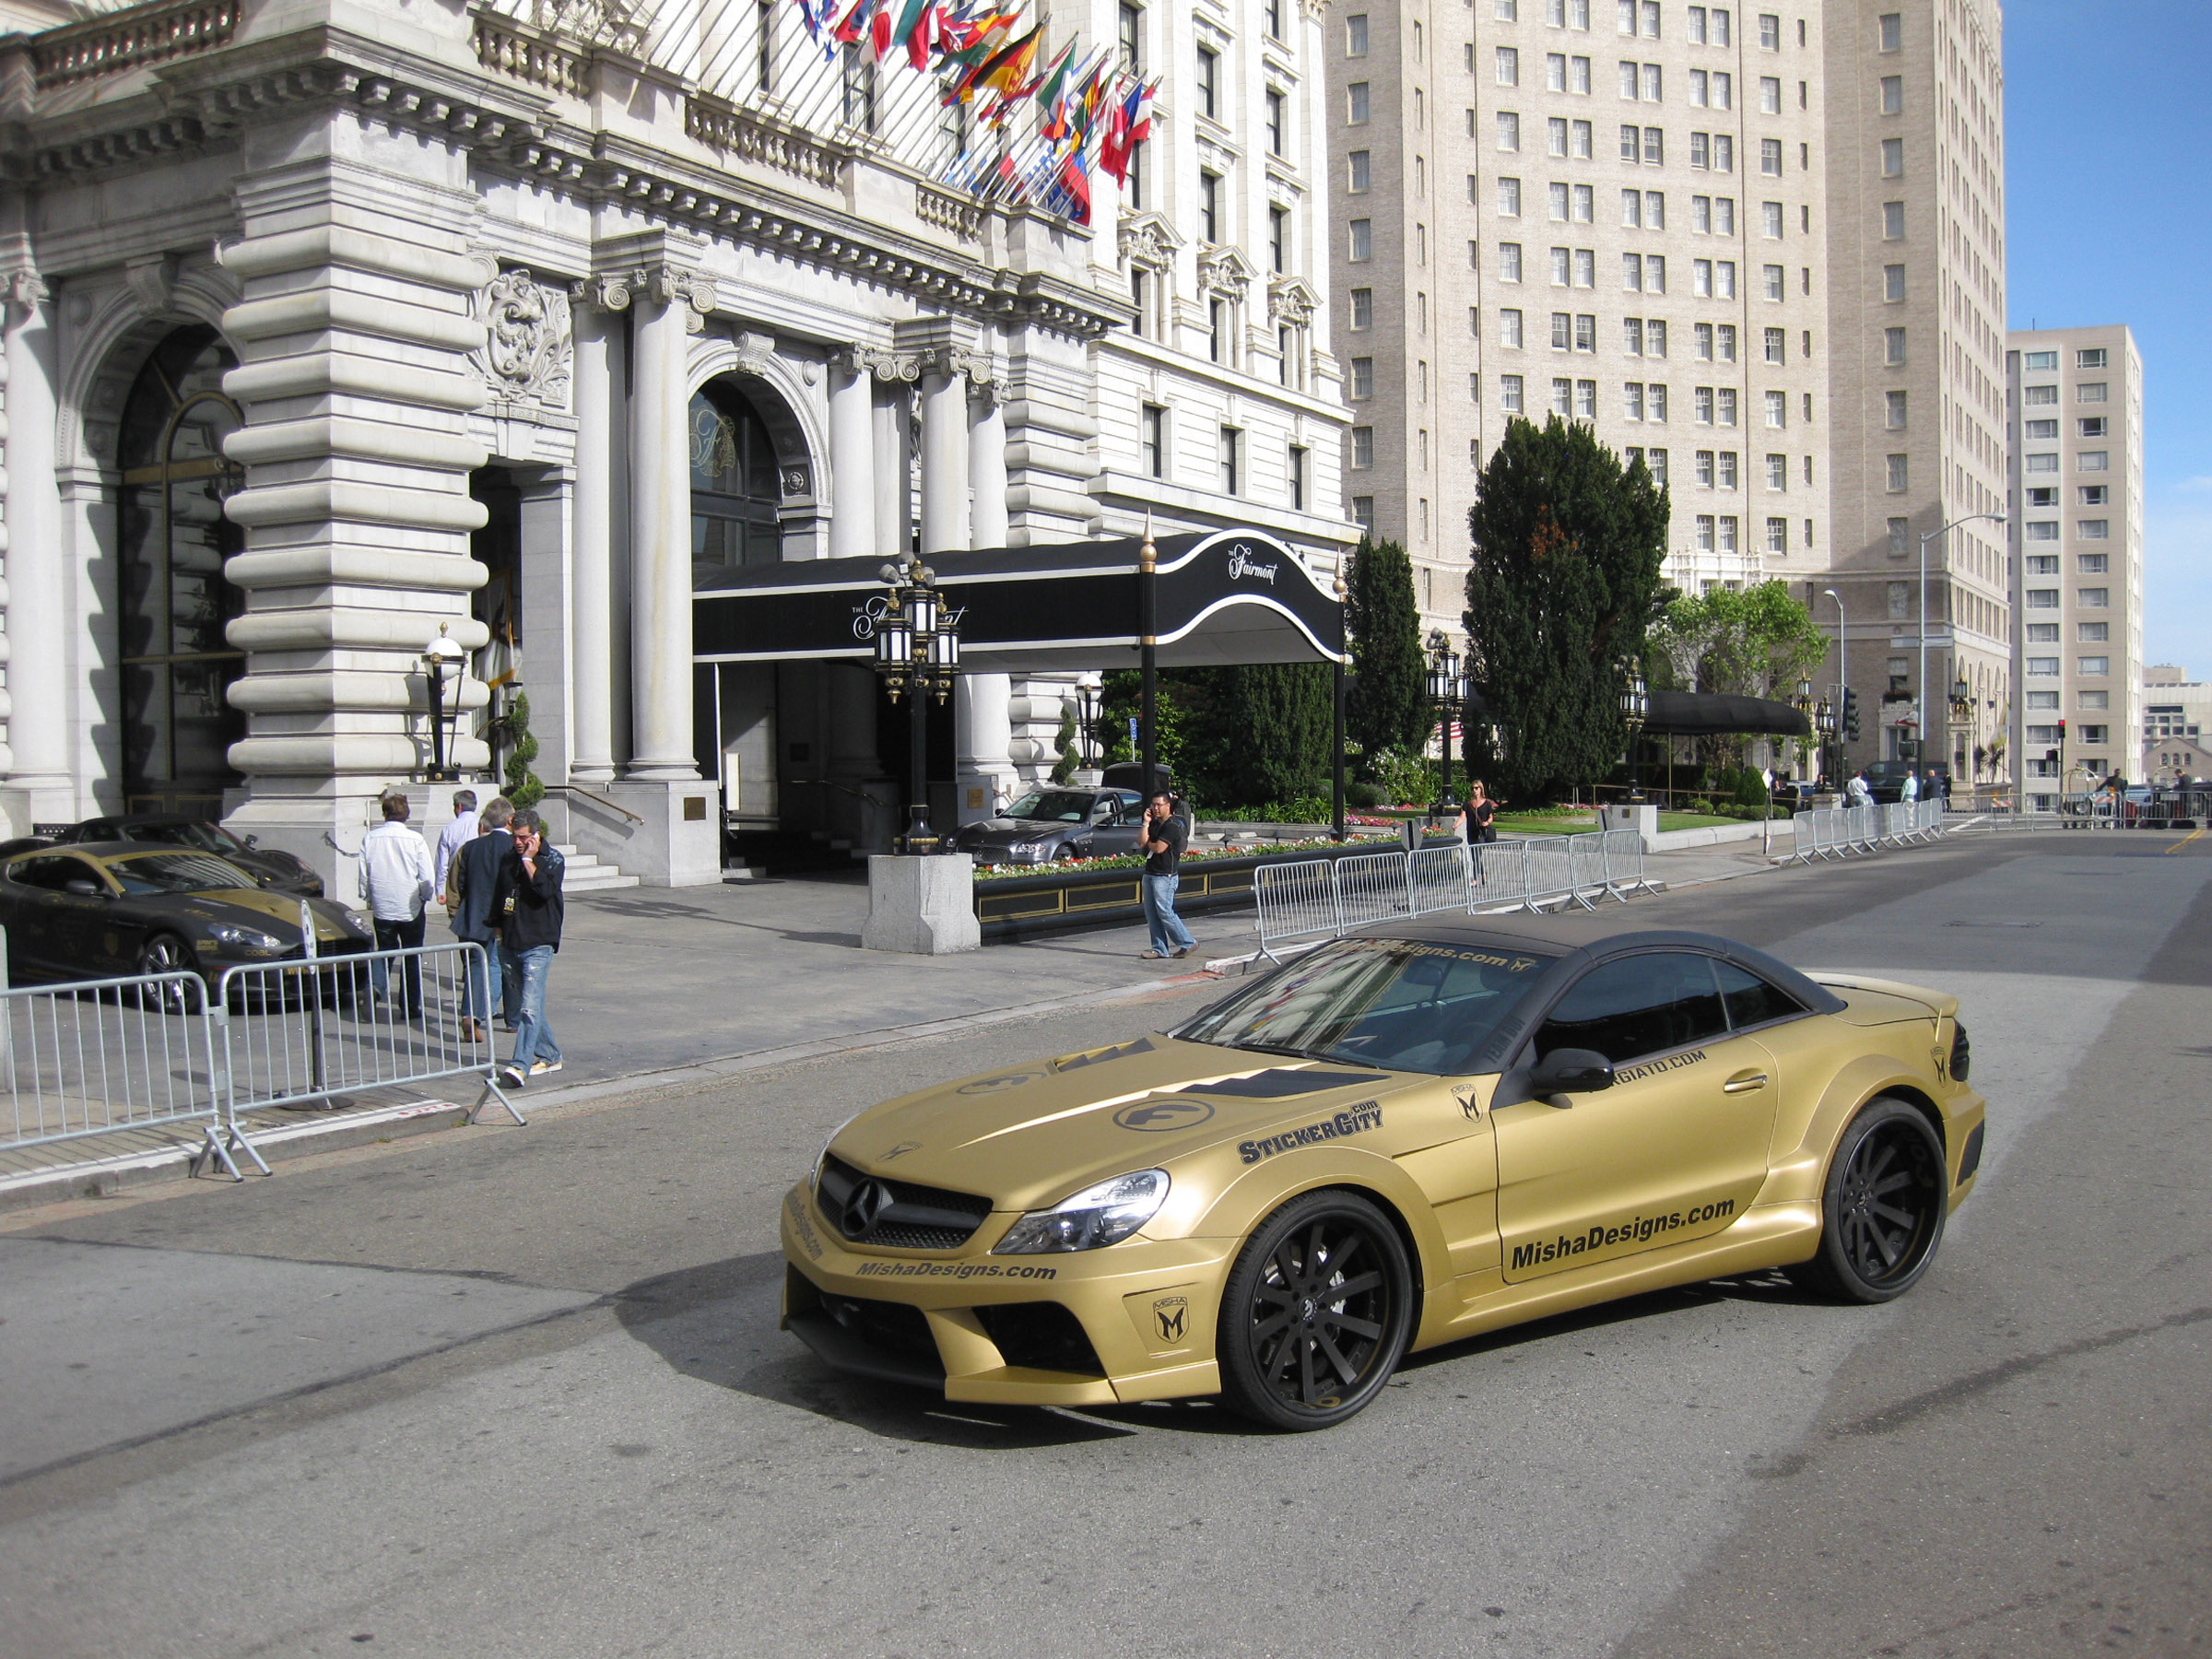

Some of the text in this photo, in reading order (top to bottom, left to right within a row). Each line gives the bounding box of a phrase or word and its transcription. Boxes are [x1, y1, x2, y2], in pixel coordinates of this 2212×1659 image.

[1229, 544, 1278, 585] Fairmont
[1612, 1051, 1706, 1086] RGIATO.COM
[1512, 1199, 1735, 1270] MishaDesigns.com
[855, 1262, 1056, 1280] MishaDesigns.com
